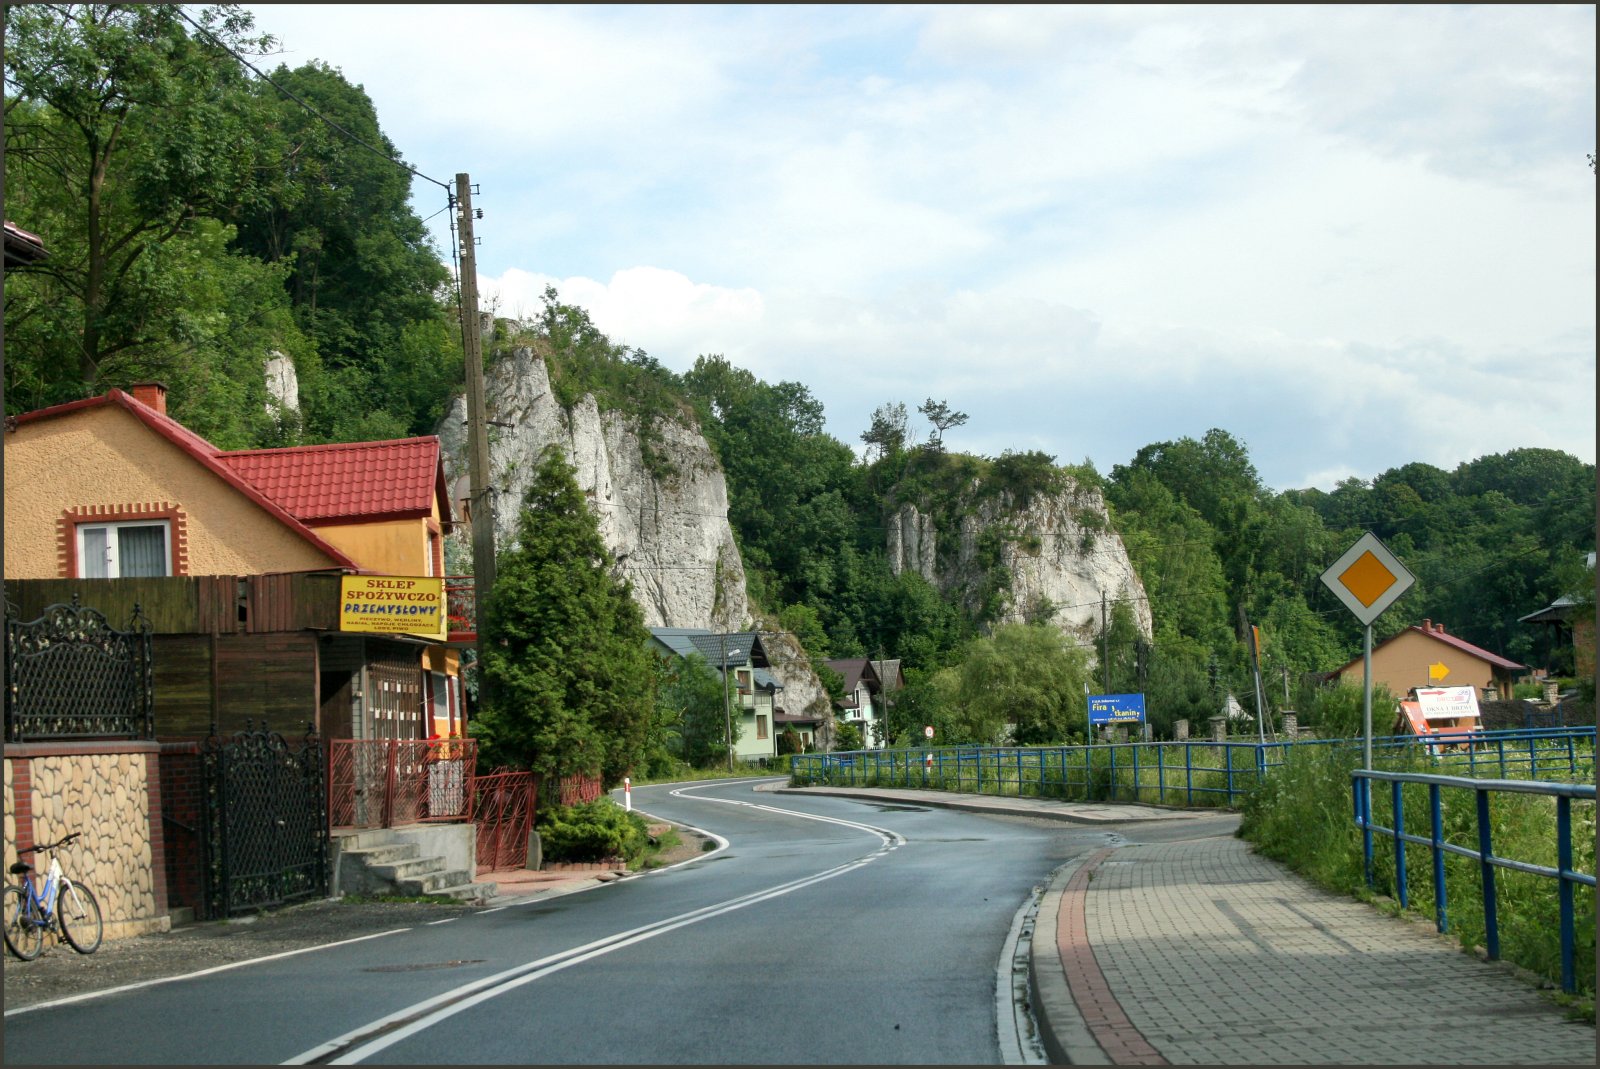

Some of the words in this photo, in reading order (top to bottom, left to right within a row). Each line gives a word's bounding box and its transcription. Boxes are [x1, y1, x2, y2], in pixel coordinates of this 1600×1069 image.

[366, 580, 416, 589] SKLEP
[346, 589, 440, 601] SPOŻYWCZO-
[344, 603, 437, 615] PRZEMYSŁOWY
